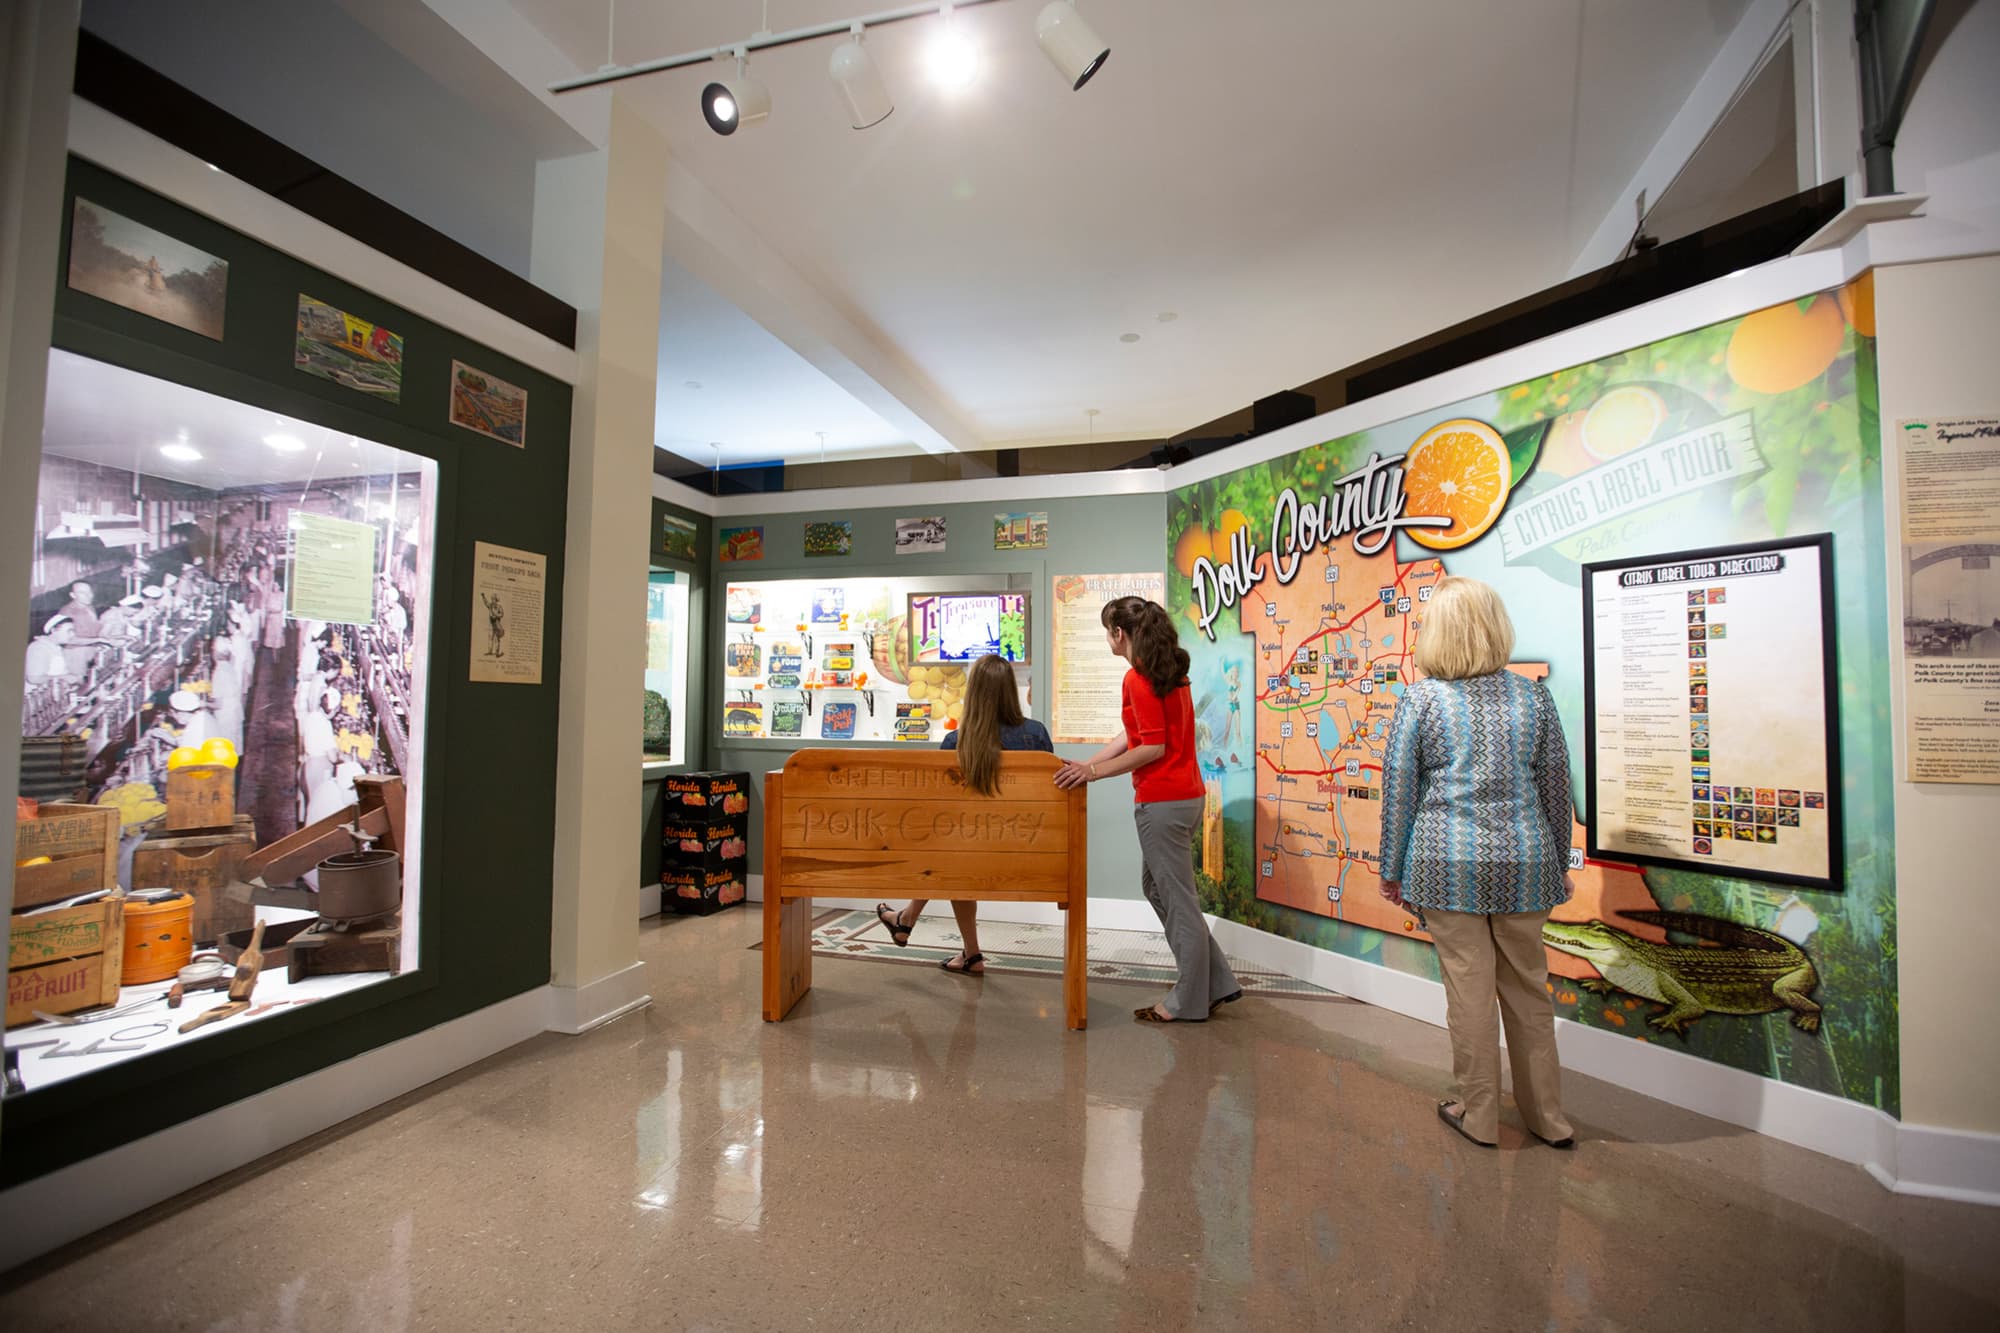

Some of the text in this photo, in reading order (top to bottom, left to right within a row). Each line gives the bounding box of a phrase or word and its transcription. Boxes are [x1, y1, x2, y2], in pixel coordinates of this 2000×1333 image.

[1514, 431, 1734, 547] CITRUS LABEL TOUR
[1192, 453, 1453, 641] Polk County
[1623, 555, 1779, 586] CITRUS LABEL TOUR DIRECTORY
[667, 780, 700, 792] Florida
[710, 779, 737, 794] Florida
[799, 803, 1046, 844] Polk County
[664, 827, 697, 838] Florida
[707, 825, 735, 840] Florida
[662, 872, 695, 884] Florida
[704, 869, 733, 886] Florida
